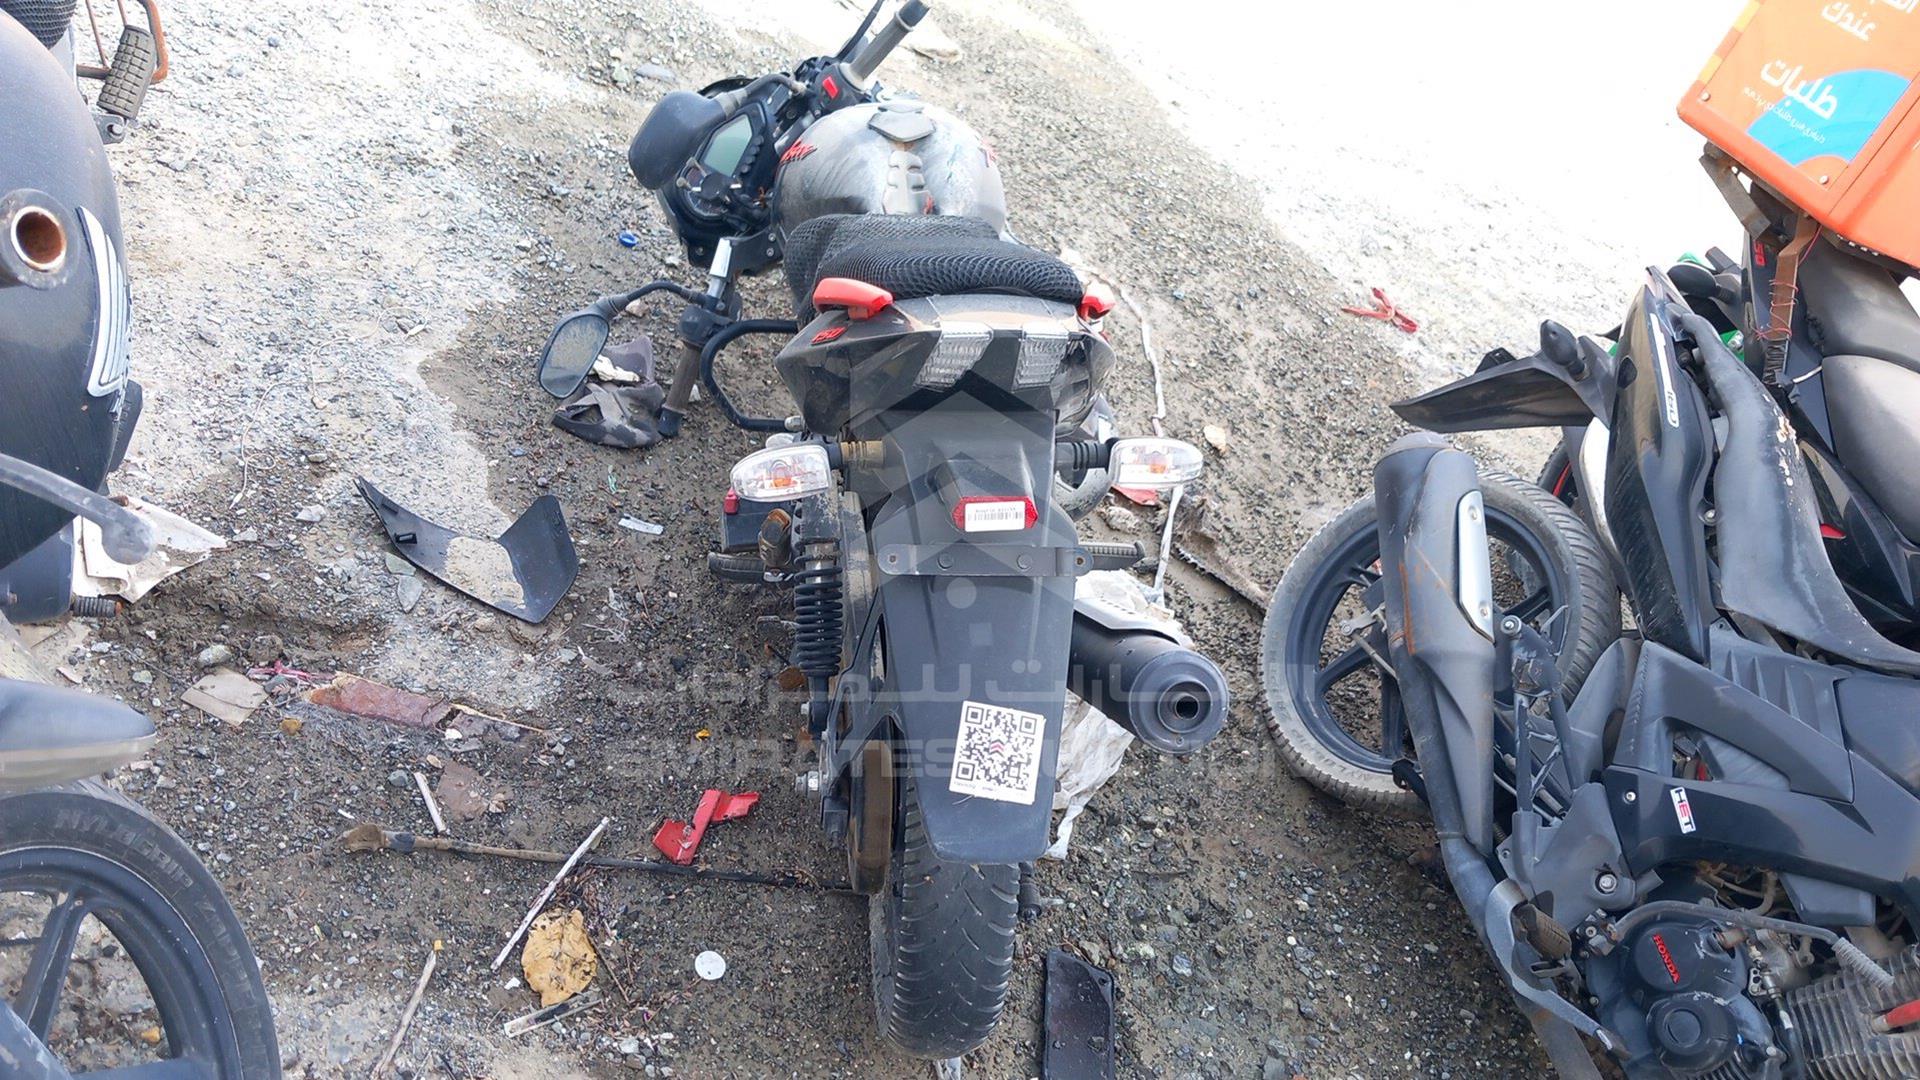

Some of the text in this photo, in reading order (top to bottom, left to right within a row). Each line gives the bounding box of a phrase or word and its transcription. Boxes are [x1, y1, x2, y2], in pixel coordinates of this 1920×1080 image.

[1821, 1, 1877, 42] عندك
[1760, 60, 1838, 120] طلبات
[1674, 788, 1695, 831] HET
[1651, 933, 1681, 984] HONDA
